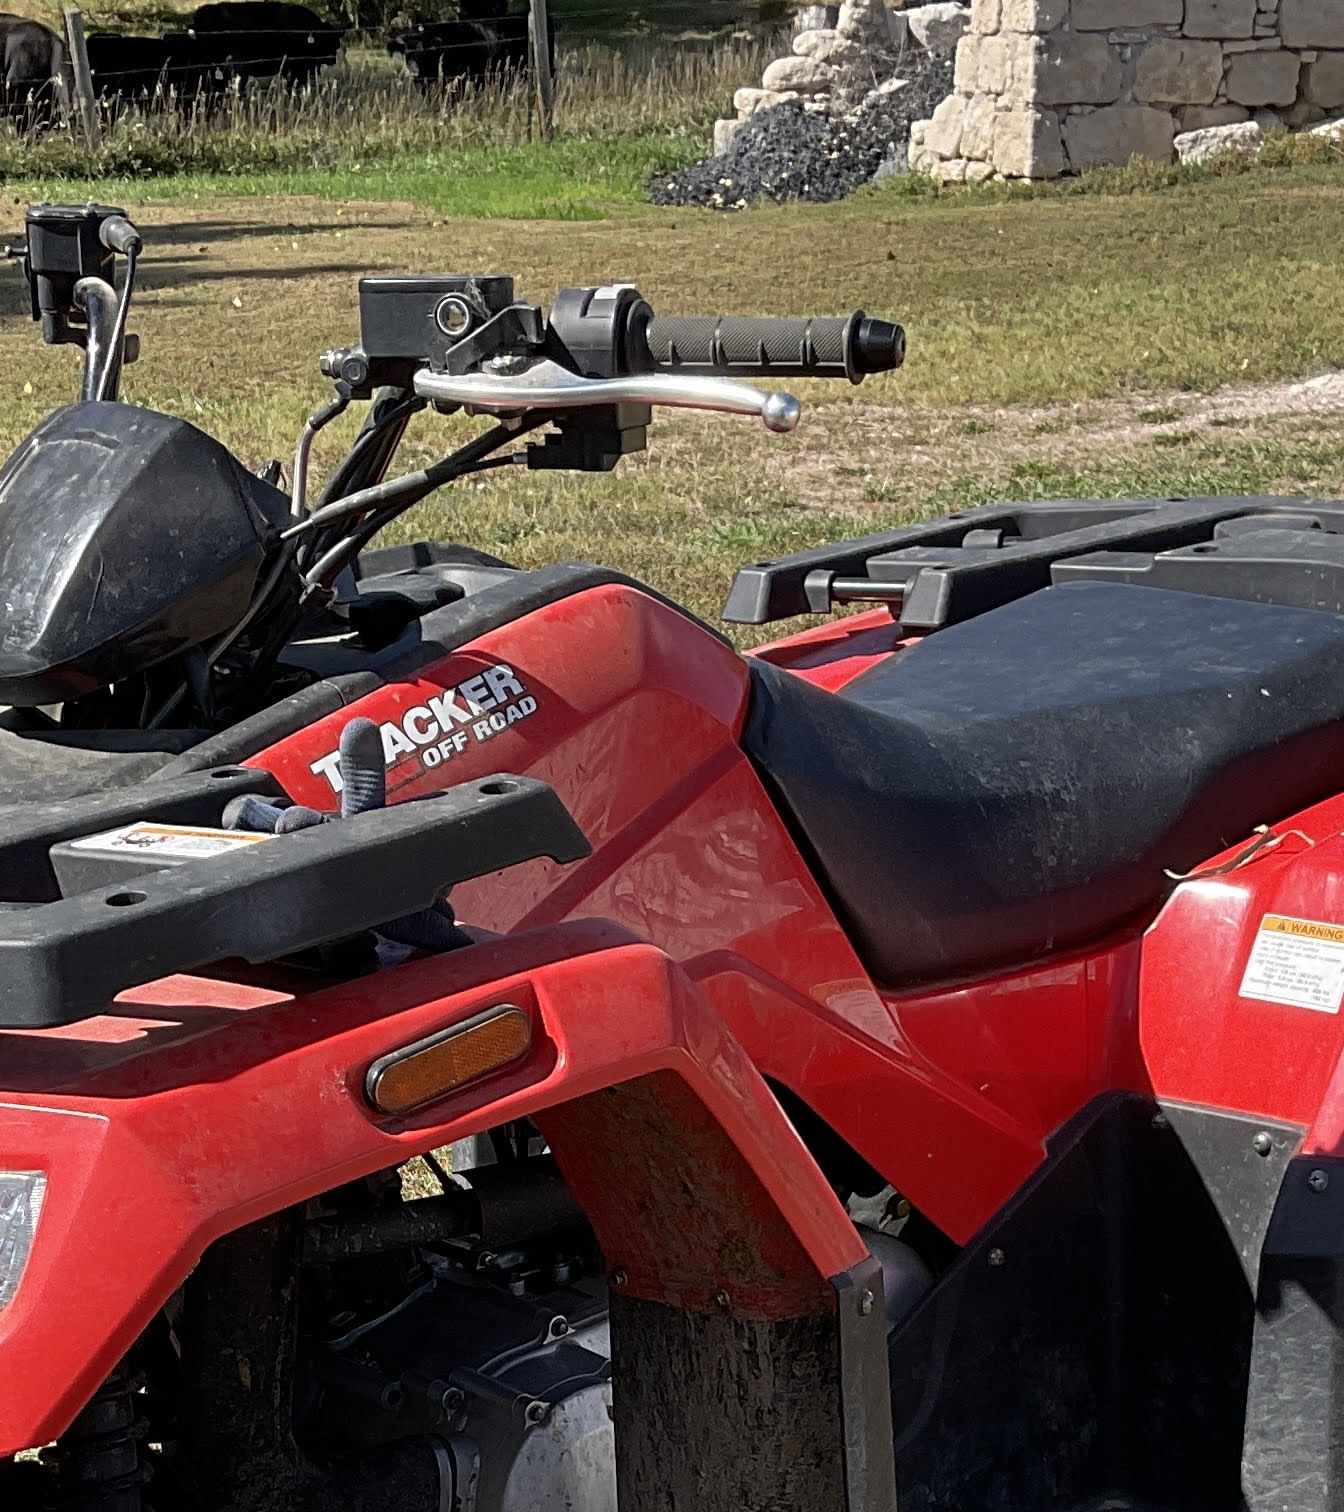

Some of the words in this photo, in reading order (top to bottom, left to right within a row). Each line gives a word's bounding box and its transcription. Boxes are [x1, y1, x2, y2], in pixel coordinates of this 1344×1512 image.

[309, 664, 524, 793] TACKER
[422, 731, 469, 767] OFF
[472, 696, 538, 742] ROAD
[1291, 922, 1344, 940] WARNING
